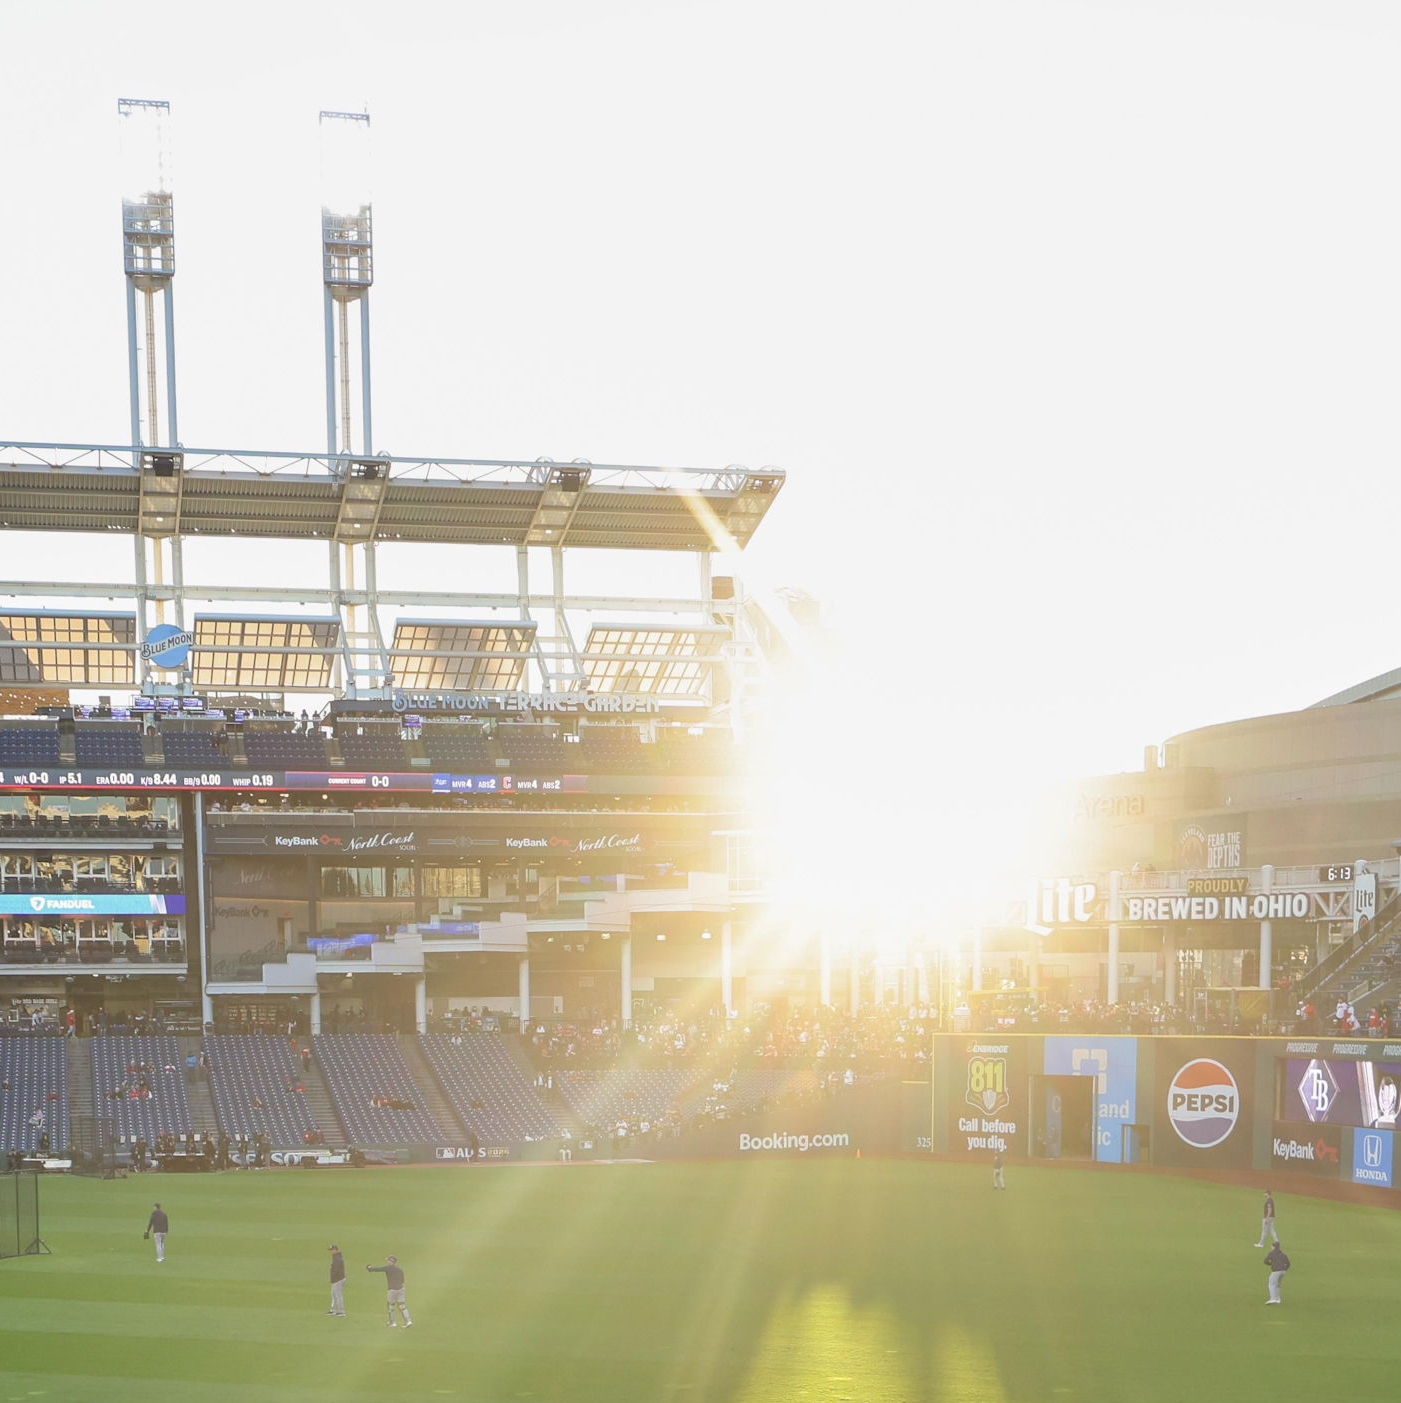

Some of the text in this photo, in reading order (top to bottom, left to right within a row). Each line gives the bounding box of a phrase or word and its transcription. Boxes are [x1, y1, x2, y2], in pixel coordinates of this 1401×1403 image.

[140, 632, 194, 660] BLUE MOON
[392, 692, 660, 713] BLUE MOON TERRACE GARDEN
[29, 772, 48, 784] 0-0
[68, 773, 82, 784] 5.1
[110, 773, 134, 785] 0.00
[154, 773, 177, 785] 8.44
[201, 774, 221, 786] 0.00
[233, 777, 251, 786] WHIP
[252, 774, 274, 786] 0.19
[371, 776, 390, 787] 0-0
[275, 831, 414, 852] KeyBank North Coast
[506, 838, 548, 848] KeyBank
[1207, 831, 1241, 847] FEAR THE
[1207, 844, 1241, 868] DEPTHS
[1327, 867, 1351, 881] 6:13
[1187, 878, 1246, 894] PROUDLY
[47, 899, 95, 909] FANDUEL
[1128, 893, 1309, 922] BREWED IN OHIO
[1355, 888, 1374, 914] Lite
[1286, 1042, 1319, 1053] PROGRESSIVE
[1333, 1043, 1368, 1055] PROGRESSIVE
[971, 1060, 1004, 1093] 811
[1172, 1093, 1235, 1113] PEPSI
[959, 1117, 1016, 1134] Call before
[739, 1130, 849, 1154] Booking.com
[917, 1137, 932, 1148] 325
[967, 1134, 1007, 1151] you dig.
[1274, 1138, 1315, 1161] KeyBank
[457, 1147, 487, 1159] ALS
[1356, 1169, 1388, 1182] HONDA
